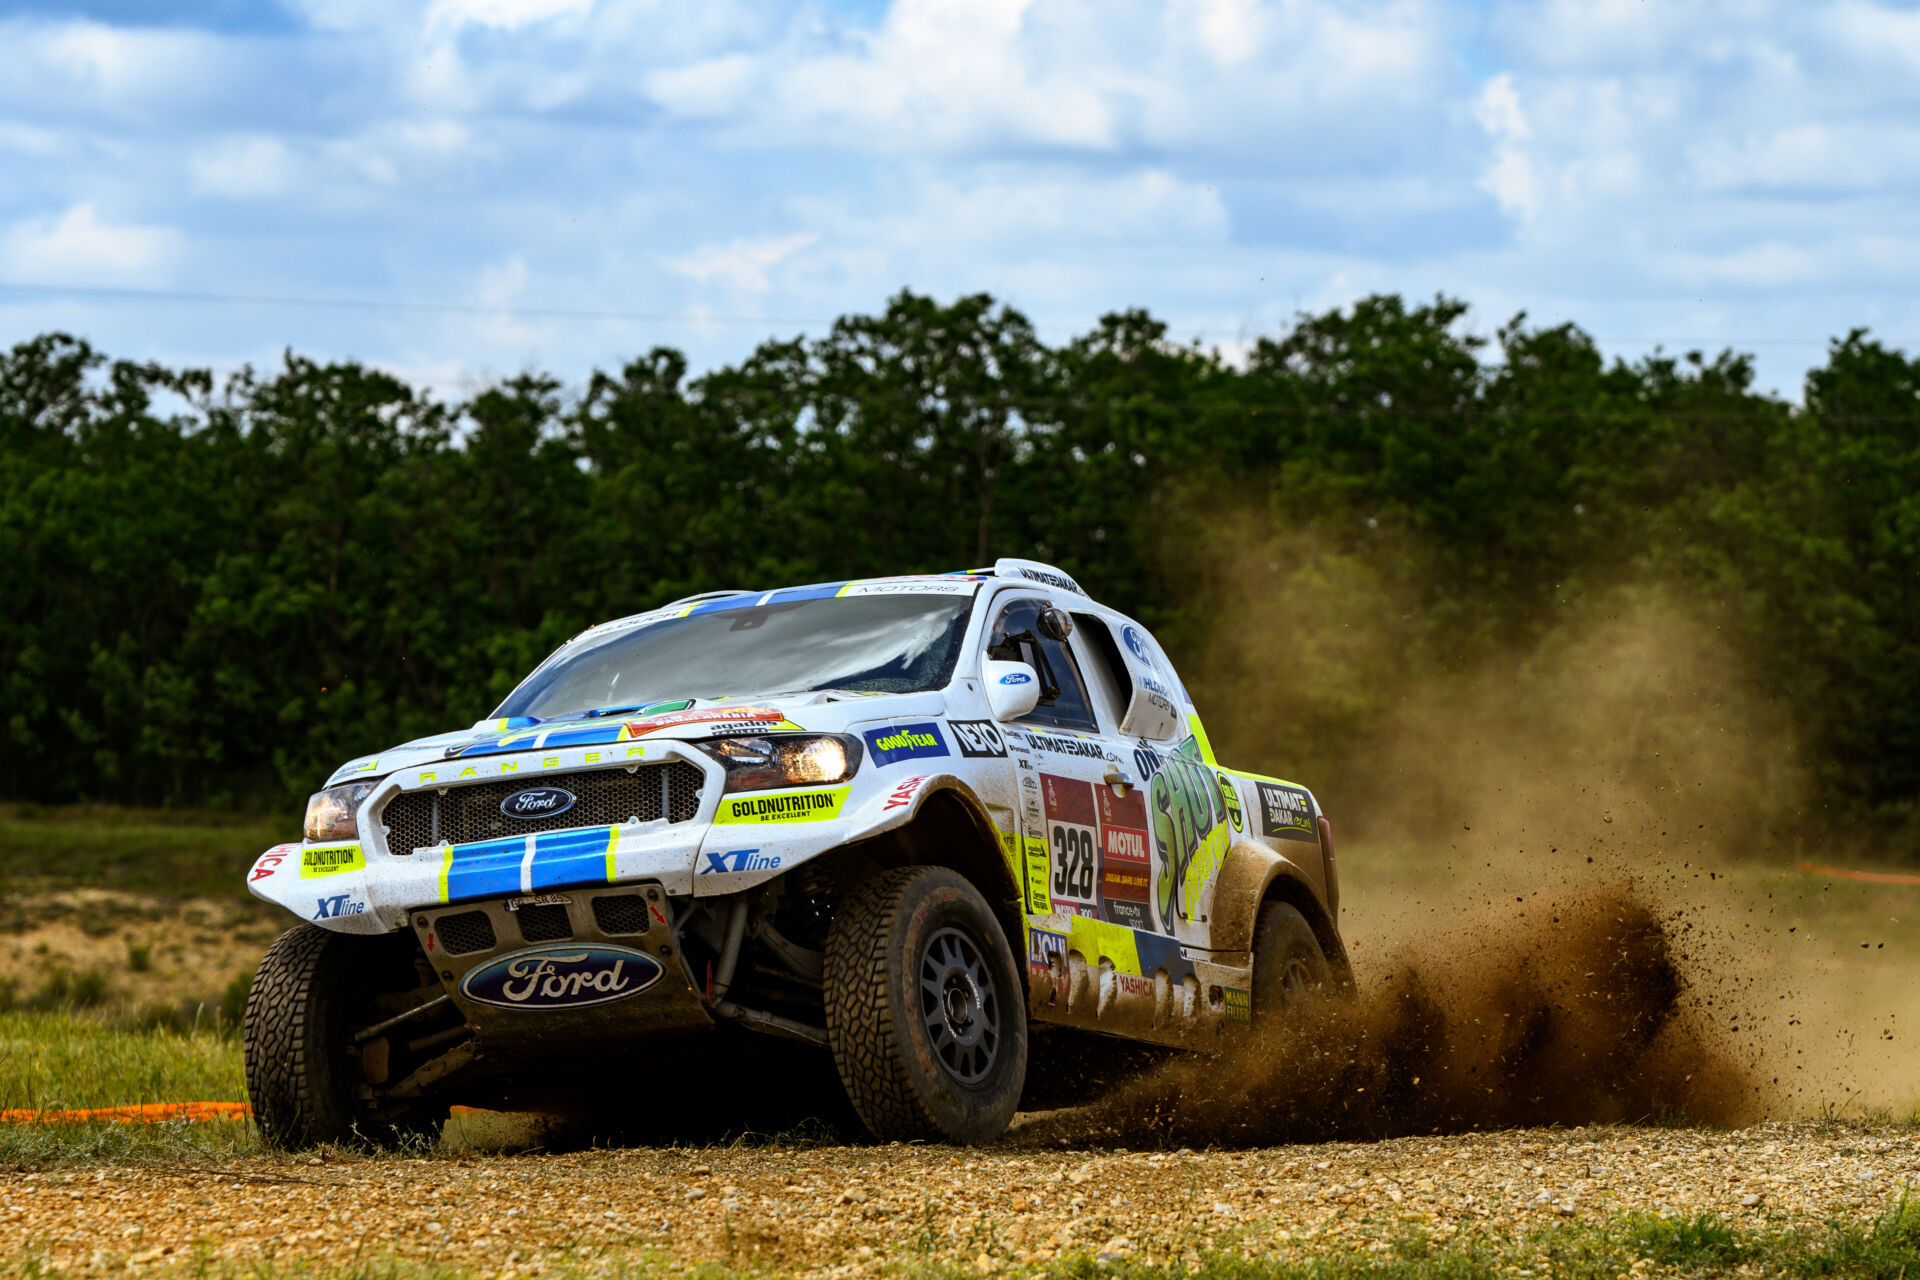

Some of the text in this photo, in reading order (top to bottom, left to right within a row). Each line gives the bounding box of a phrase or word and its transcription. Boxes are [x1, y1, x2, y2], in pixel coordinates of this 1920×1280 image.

[1005, 674, 1026, 684] Ford
[875, 729, 939, 751] GOODYEAR
[419, 746, 645, 783] RANGER
[515, 791, 556, 811] Ford
[731, 792, 834, 818] GOLDNUTRITION
[1263, 788, 1308, 813] ULTIMATE
[771, 811, 811, 820] EXCELLENT
[1107, 830, 1145, 858] MOTUL
[1053, 825, 1094, 900] 328
[313, 893, 365, 920] XTline
[502, 953, 630, 1002] Ford
[1120, 976, 1155, 998] YASHICA
